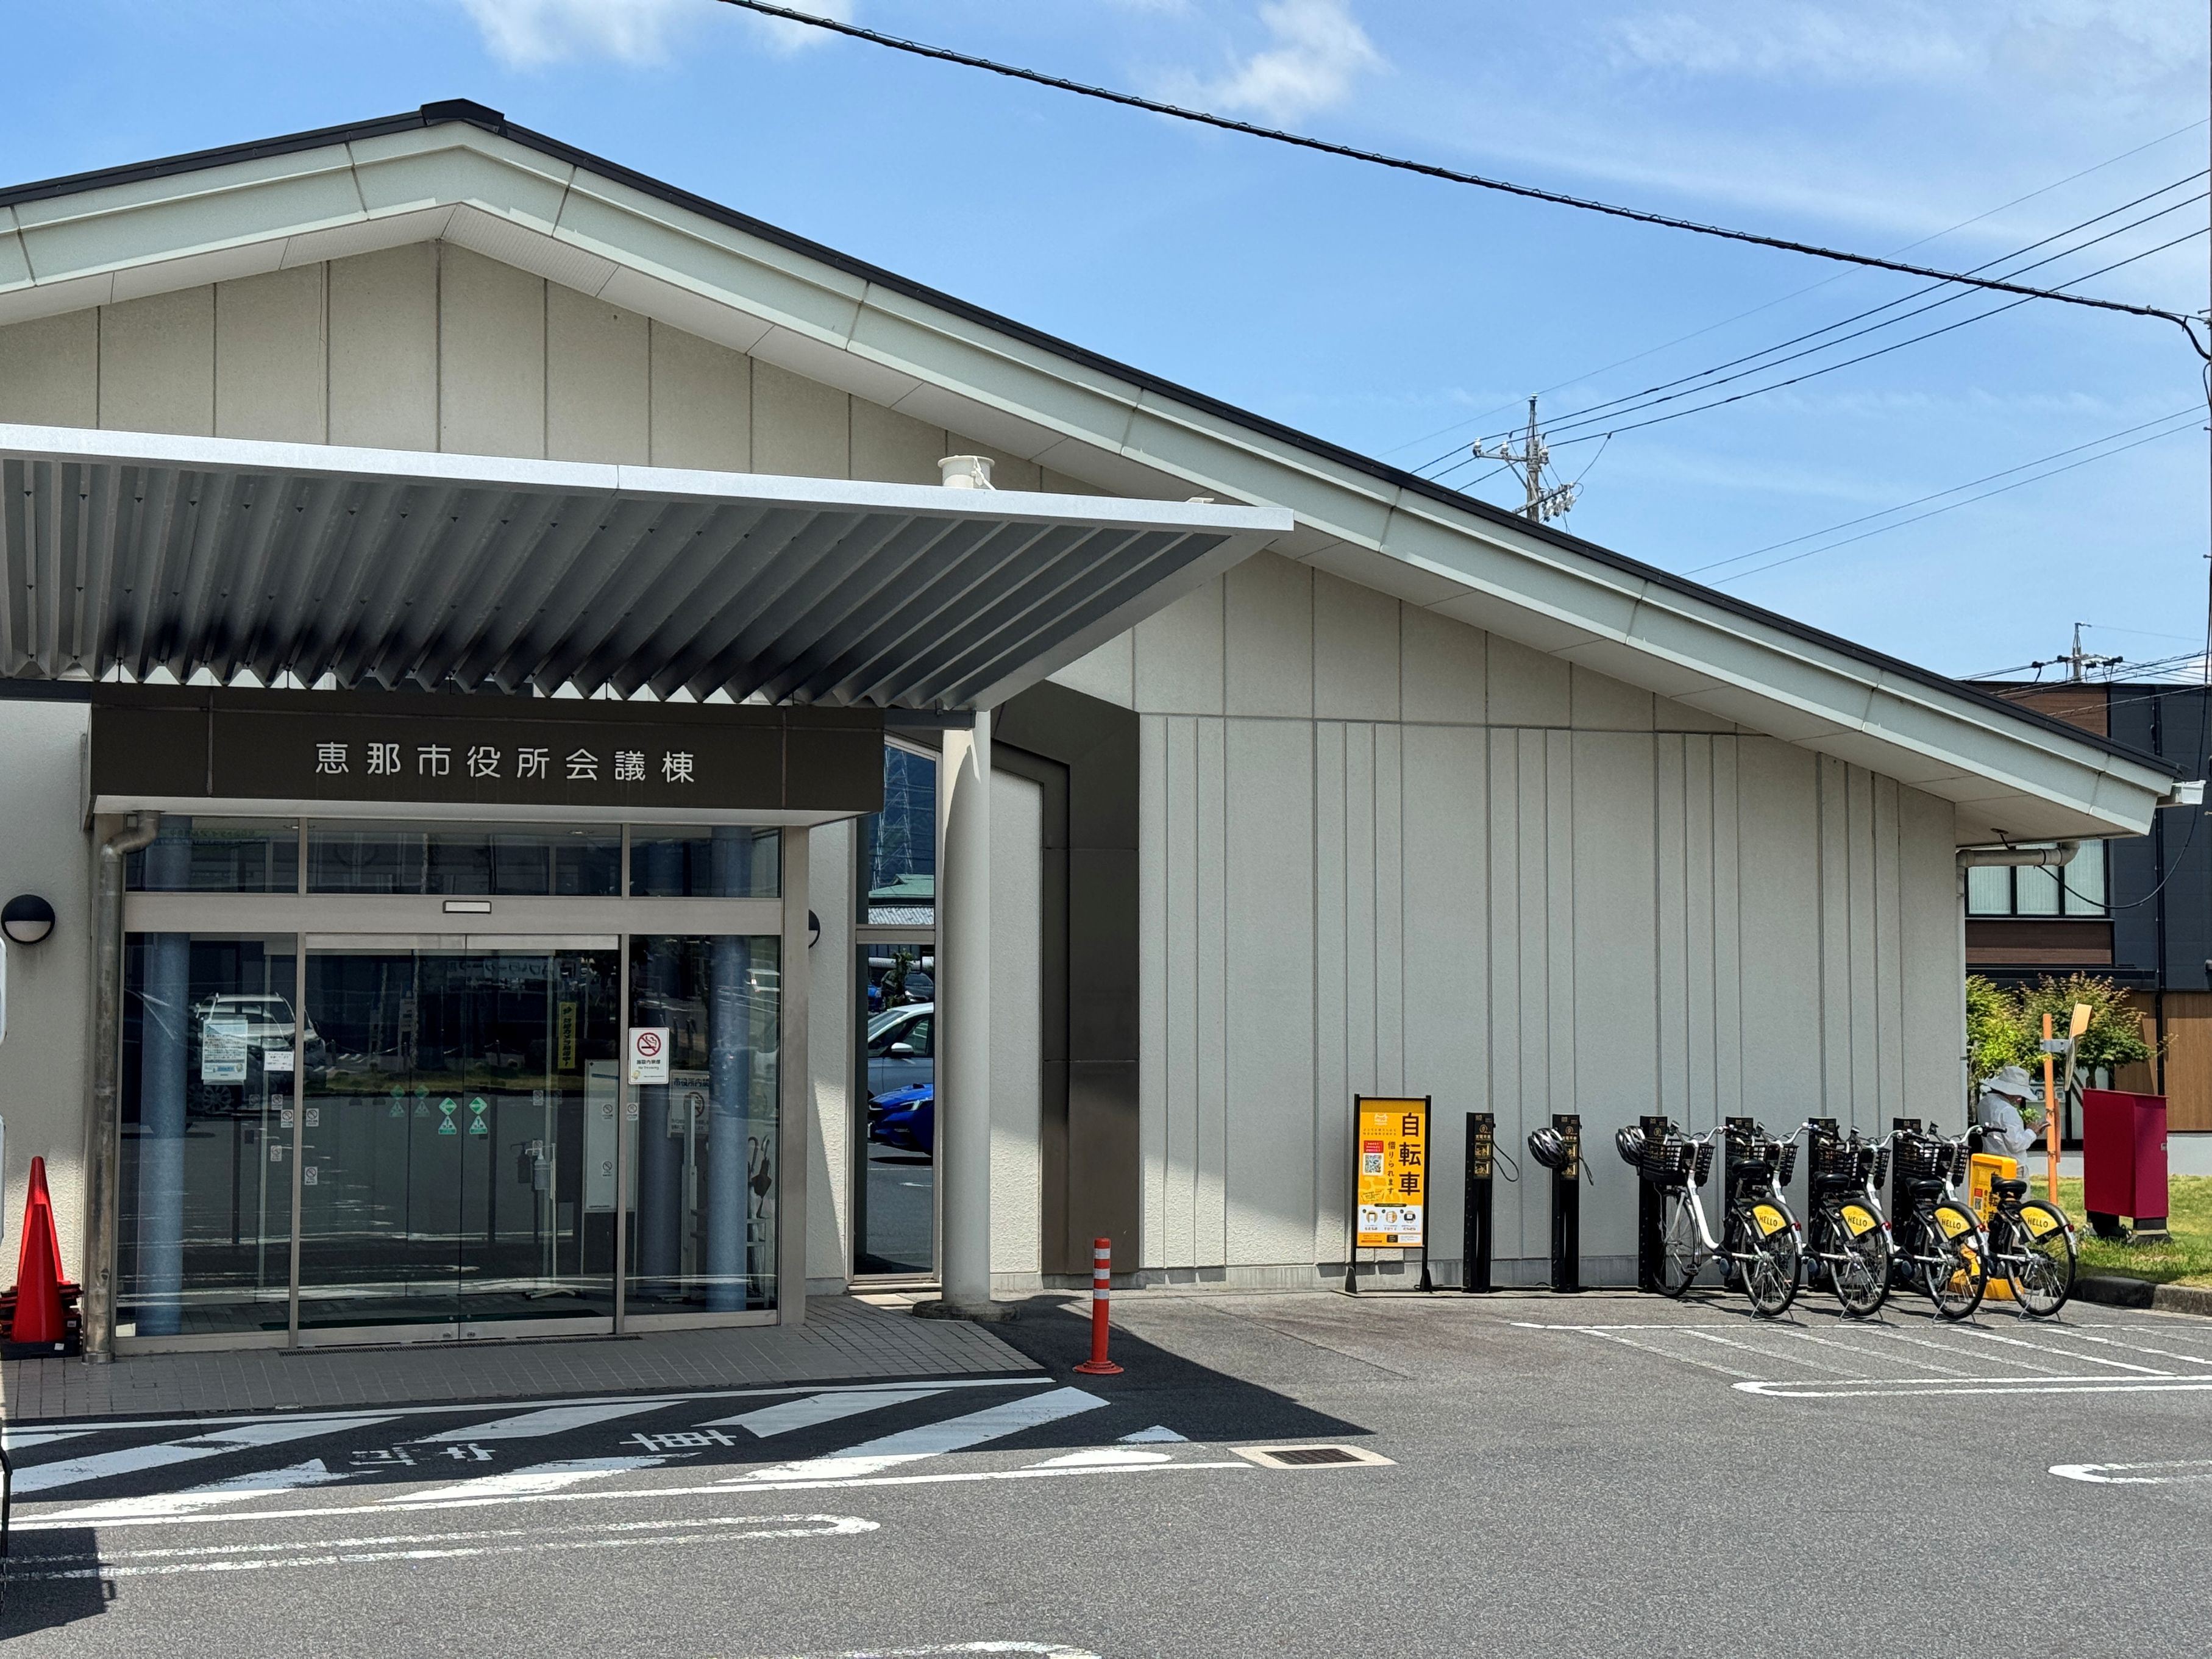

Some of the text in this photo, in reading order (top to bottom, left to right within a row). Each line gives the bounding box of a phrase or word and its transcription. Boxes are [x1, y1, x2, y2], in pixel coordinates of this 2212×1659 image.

[315, 741, 695, 784] 恵那市役所会議棟
[1398, 1112, 1421, 1196] 自転車
[1387, 1140, 1396, 1195] 借りられます
[1759, 1215, 1778, 1227] HELLO
[1847, 1215, 1868, 1227] HELLO
[1941, 1218, 1961, 1230] HELLO
[2027, 1217, 2048, 1228] HELLO
